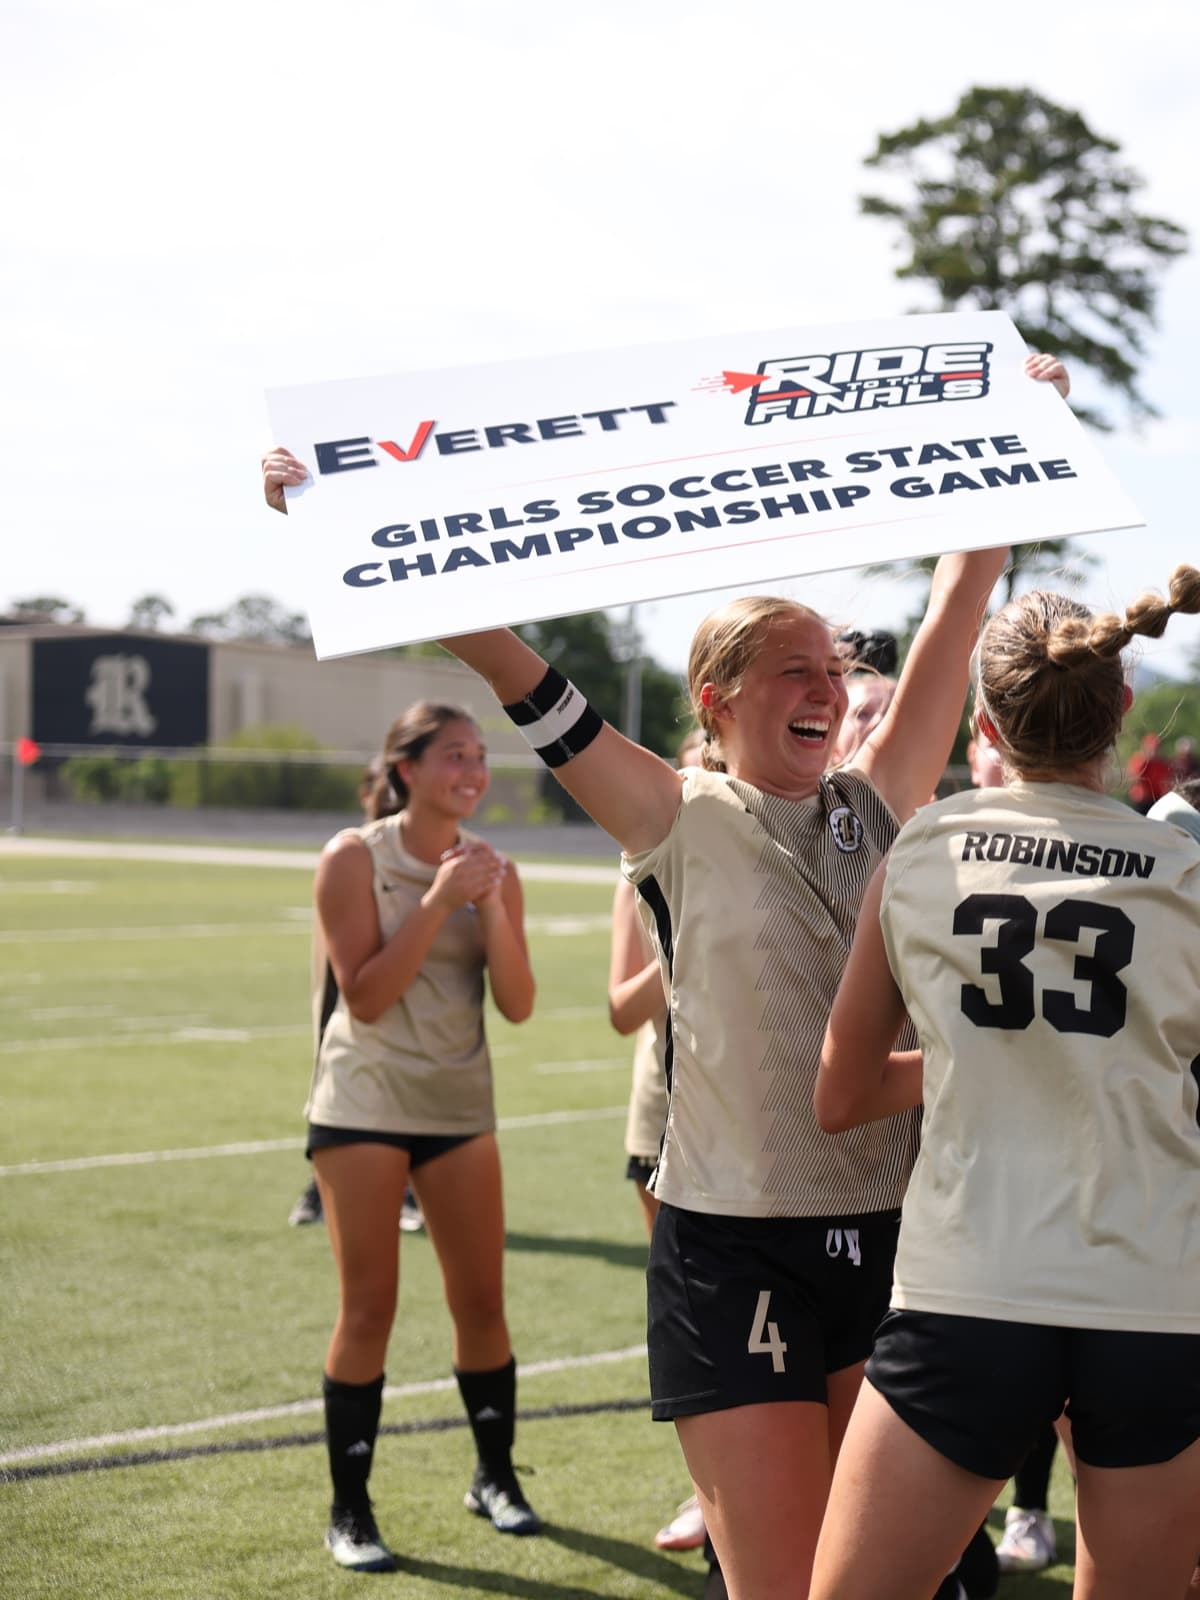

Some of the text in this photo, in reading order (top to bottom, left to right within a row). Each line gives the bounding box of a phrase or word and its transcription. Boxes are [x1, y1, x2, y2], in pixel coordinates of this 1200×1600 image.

[750, 379, 984, 424] FINALS
[757, 342, 989, 395] RIDE
[847, 374, 934, 390] TO THE
[314, 401, 675, 474] EVERETT
[342, 458, 1078, 588] CHAMPIONSHIP GAME
[371, 434, 1028, 548] GIRLS SOCCER STATE
[86, 653, 158, 737] R
[961, 831, 1156, 879] ROBINSON
[952, 893, 1136, 1038] 33
[747, 1290, 788, 1373] 4
